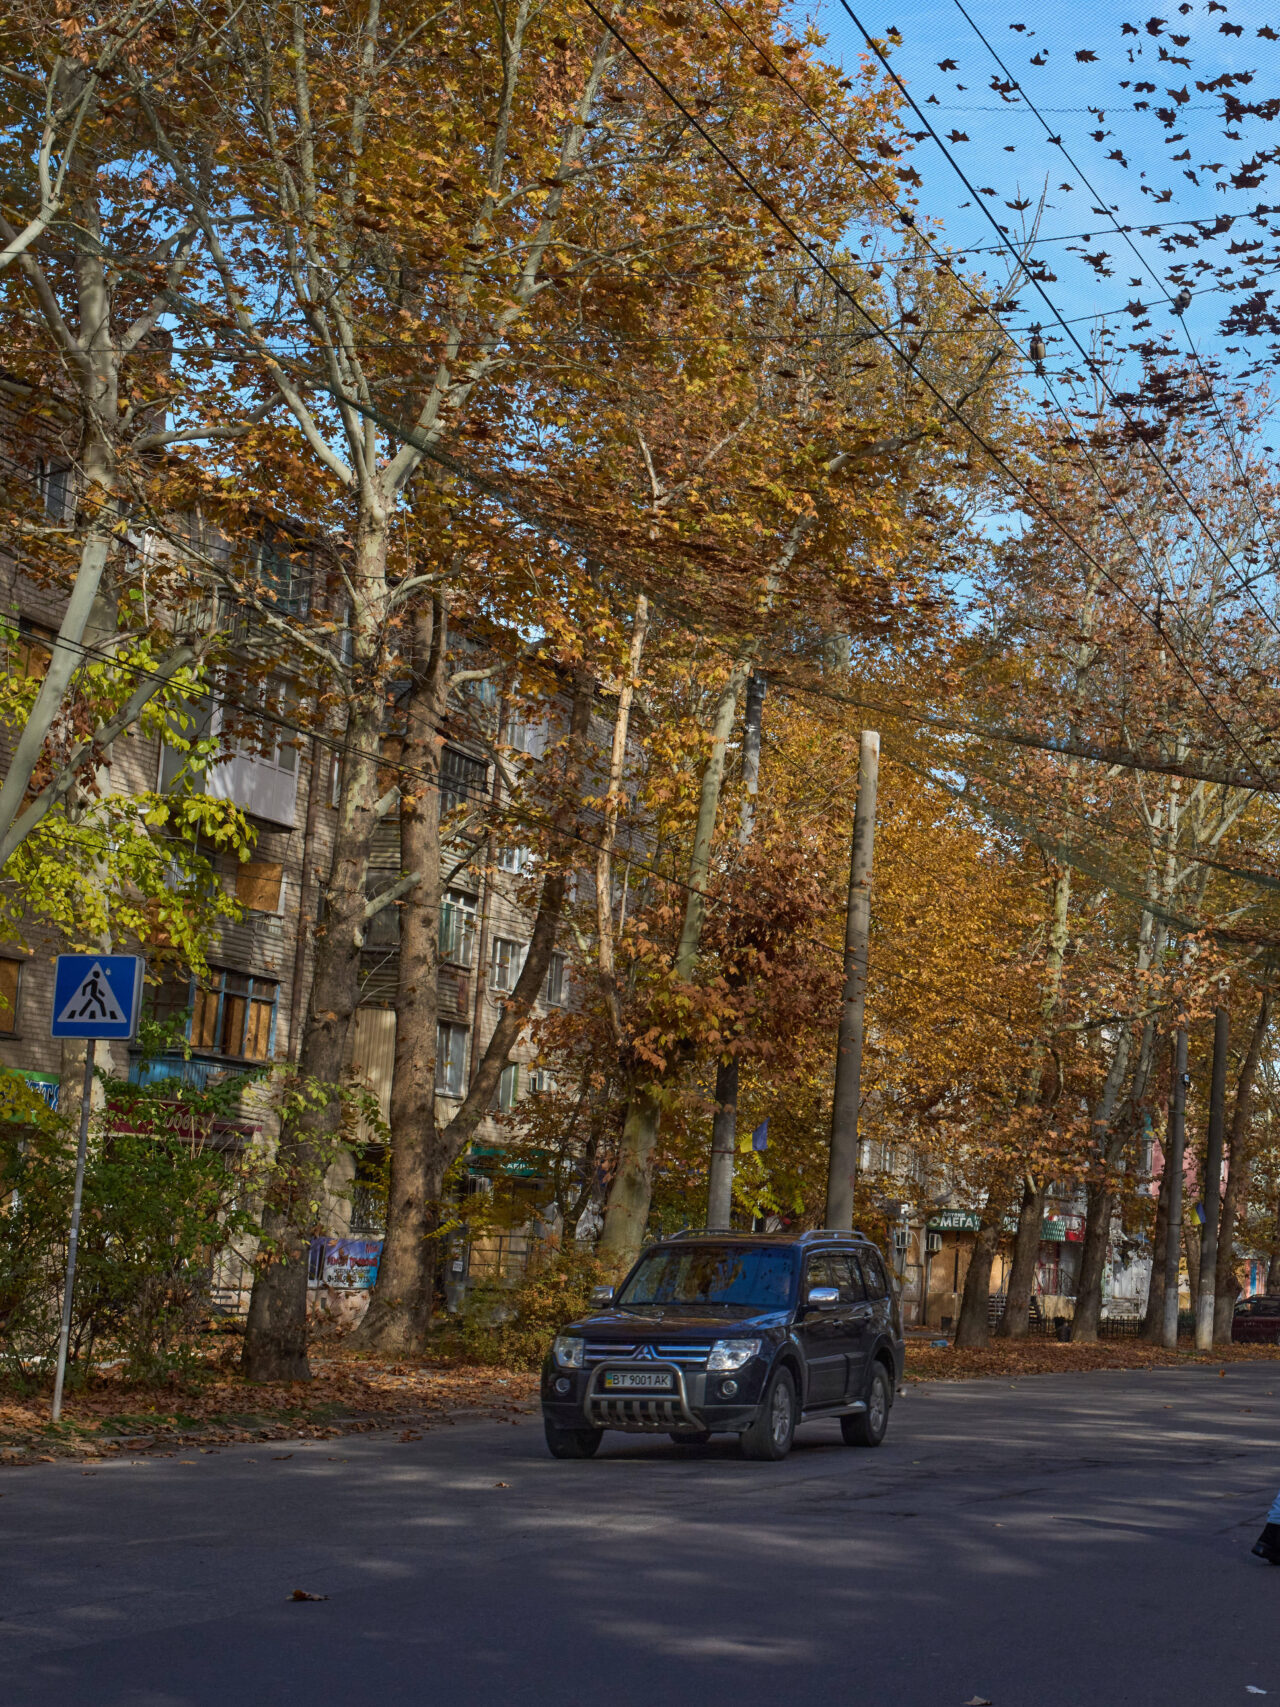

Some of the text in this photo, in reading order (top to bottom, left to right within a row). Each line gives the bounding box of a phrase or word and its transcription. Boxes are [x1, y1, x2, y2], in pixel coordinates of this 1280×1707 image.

[612, 1374, 669, 1386] BT 9001 AK
